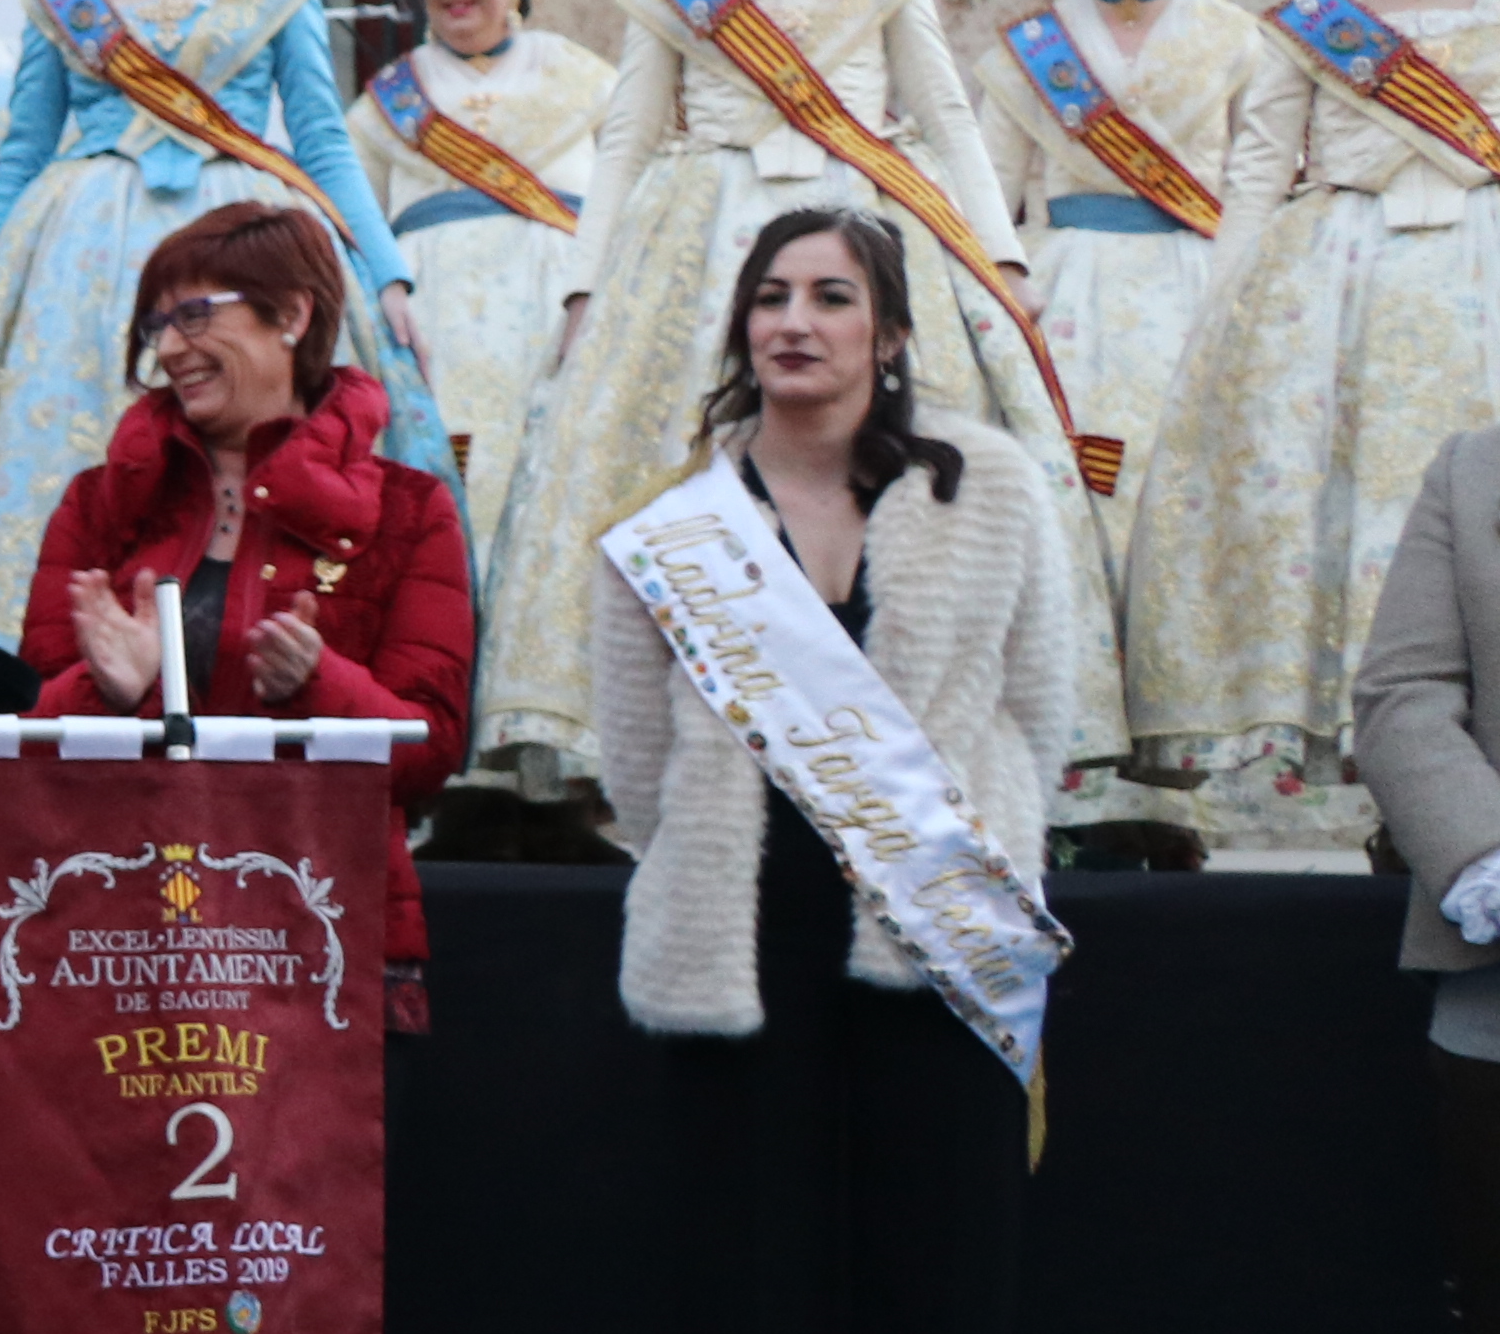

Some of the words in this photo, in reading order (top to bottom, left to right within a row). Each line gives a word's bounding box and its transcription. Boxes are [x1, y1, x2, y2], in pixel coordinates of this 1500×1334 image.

[631, 512, 784, 703] Madrina
[49, 952, 304, 988] AJUNTAMENT
[115, 991, 151, 1013] DE
[158, 989, 251, 1012] SAGUNT
[94, 1021, 271, 1075] PREMI
[118, 1072, 259, 1099] INFANTILS
[165, 1101, 239, 1202] 2
[229, 1220, 327, 1257] LOCAL
[100, 1257, 229, 1289] FALLES
[236, 1256, 290, 1285] 2019
[143, 1308, 219, 1334] FJFS
